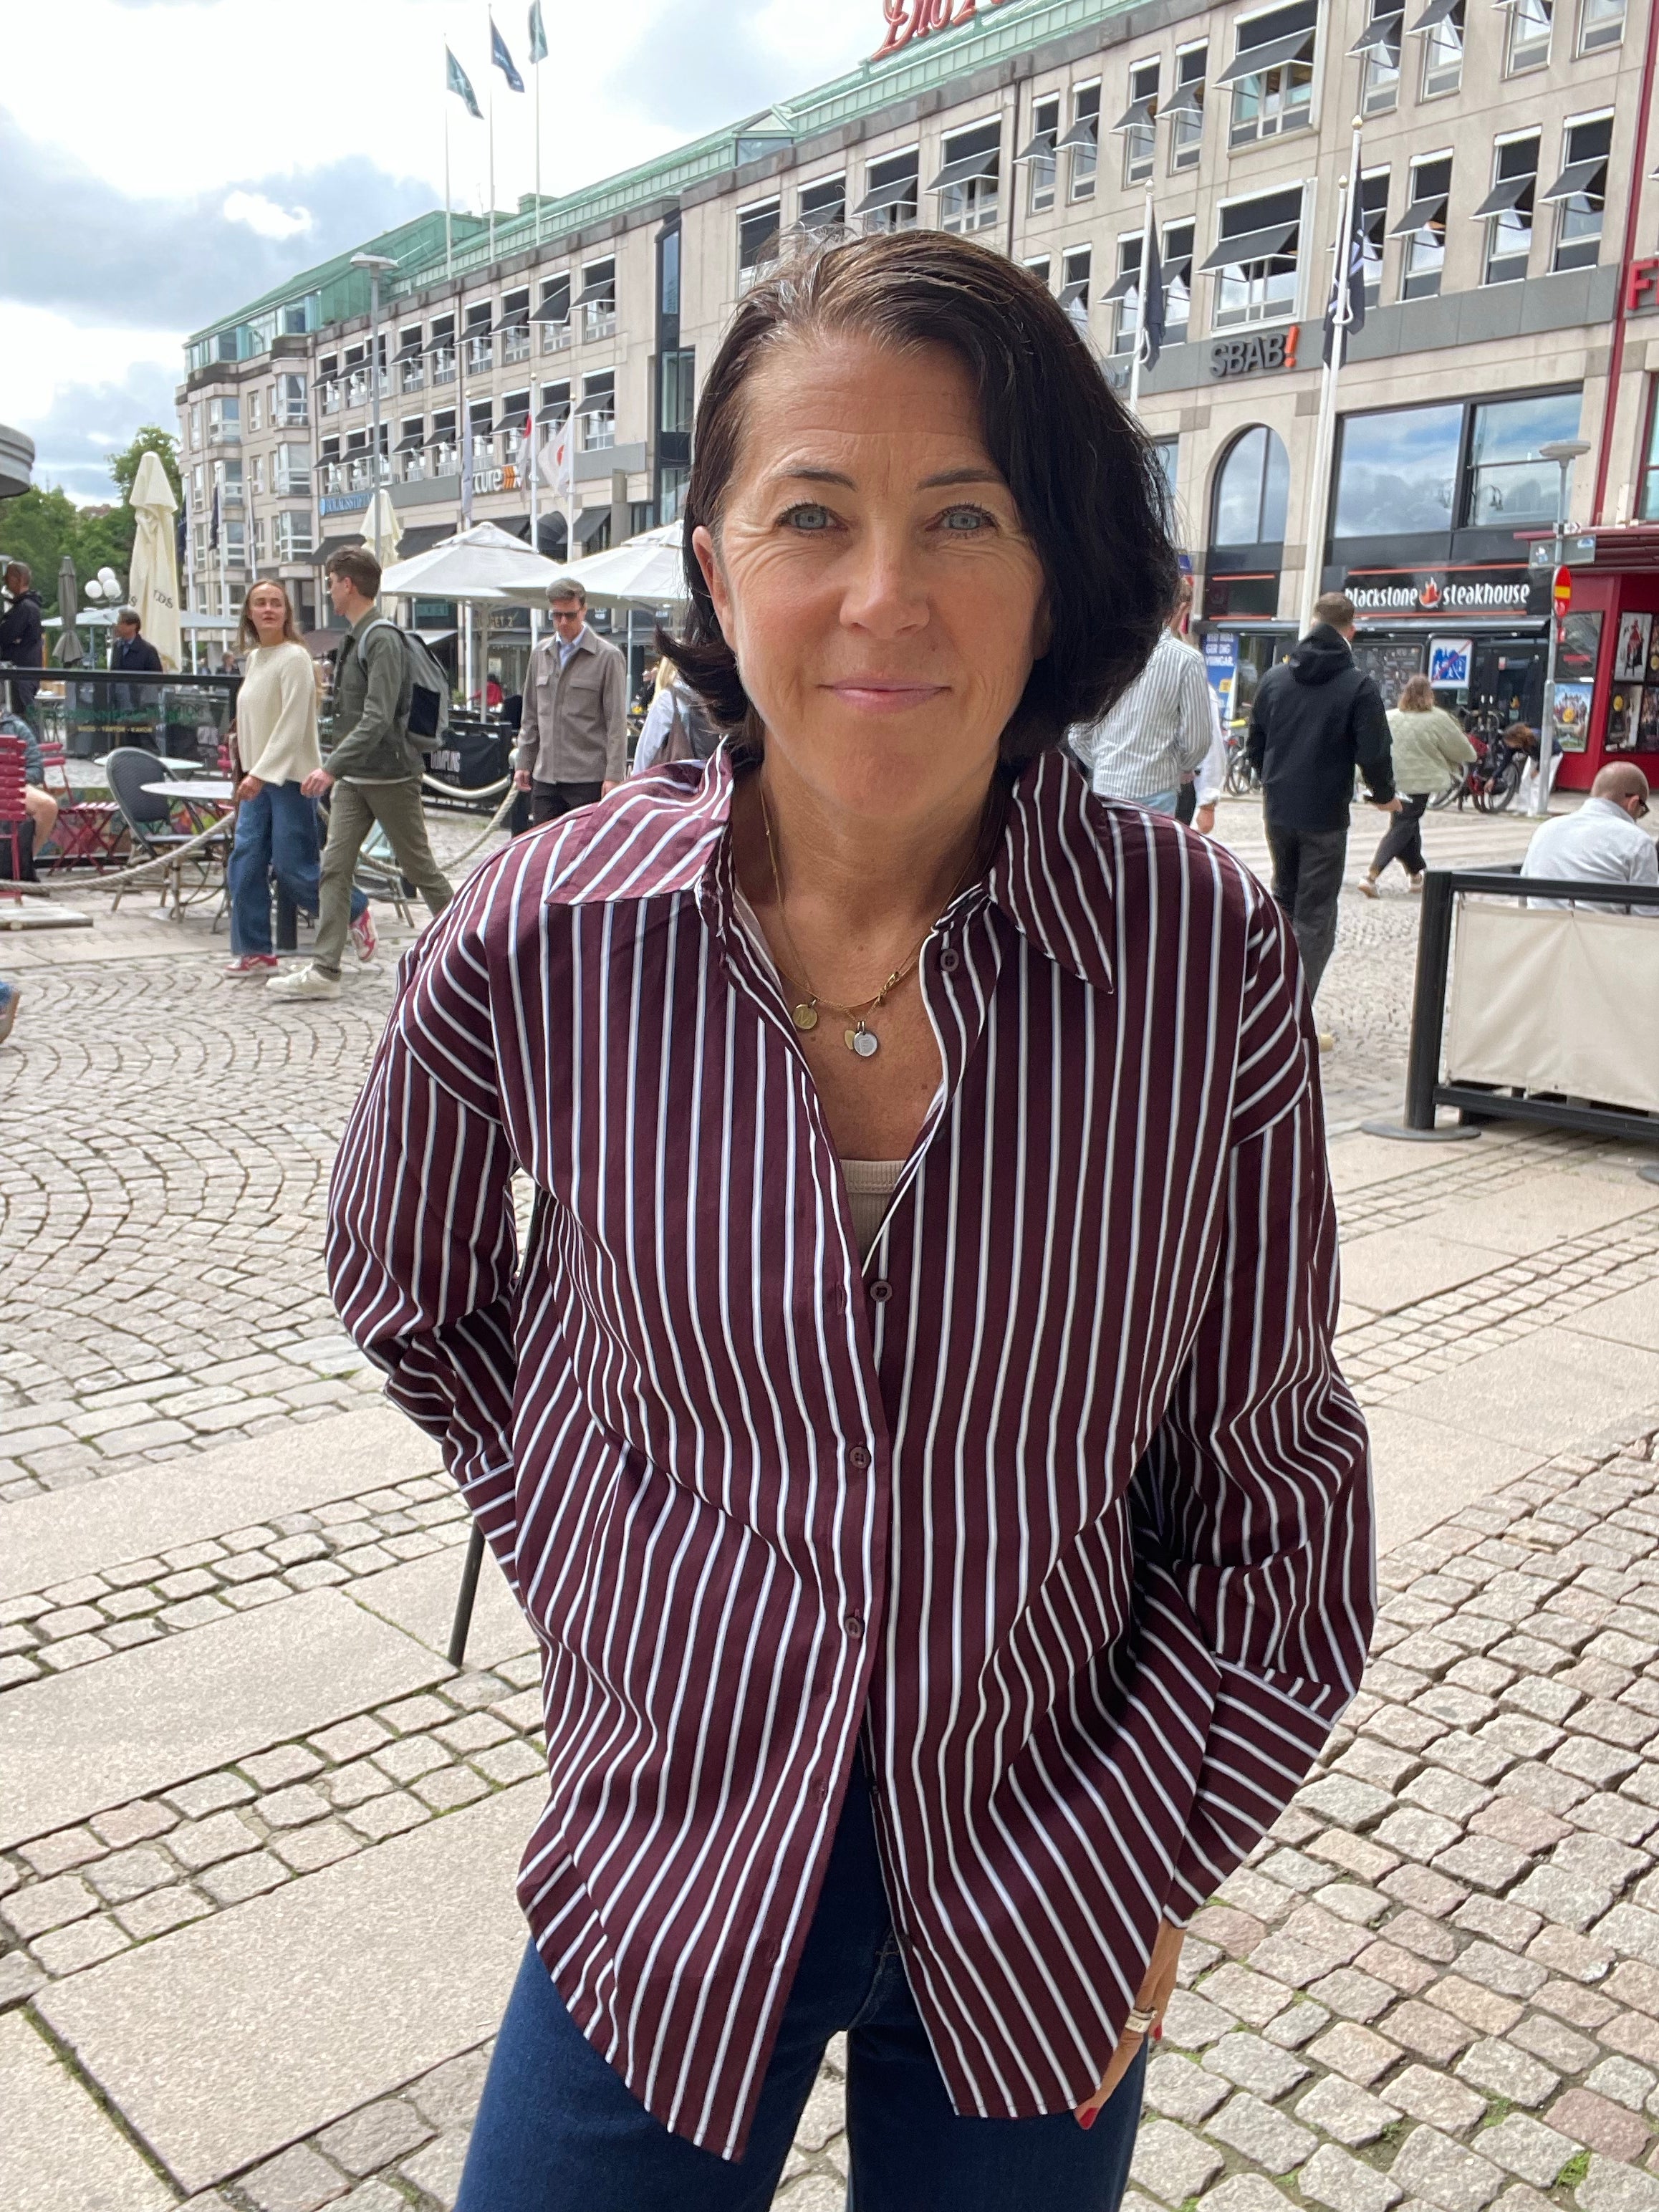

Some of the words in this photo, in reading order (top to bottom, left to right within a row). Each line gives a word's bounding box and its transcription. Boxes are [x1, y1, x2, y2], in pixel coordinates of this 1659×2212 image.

[1627, 257, 1659, 310] F
[1209, 324, 1300, 378] SBAB!
[1345, 585, 1418, 608] blackstone
[1443, 582, 1531, 607] steakhouse
